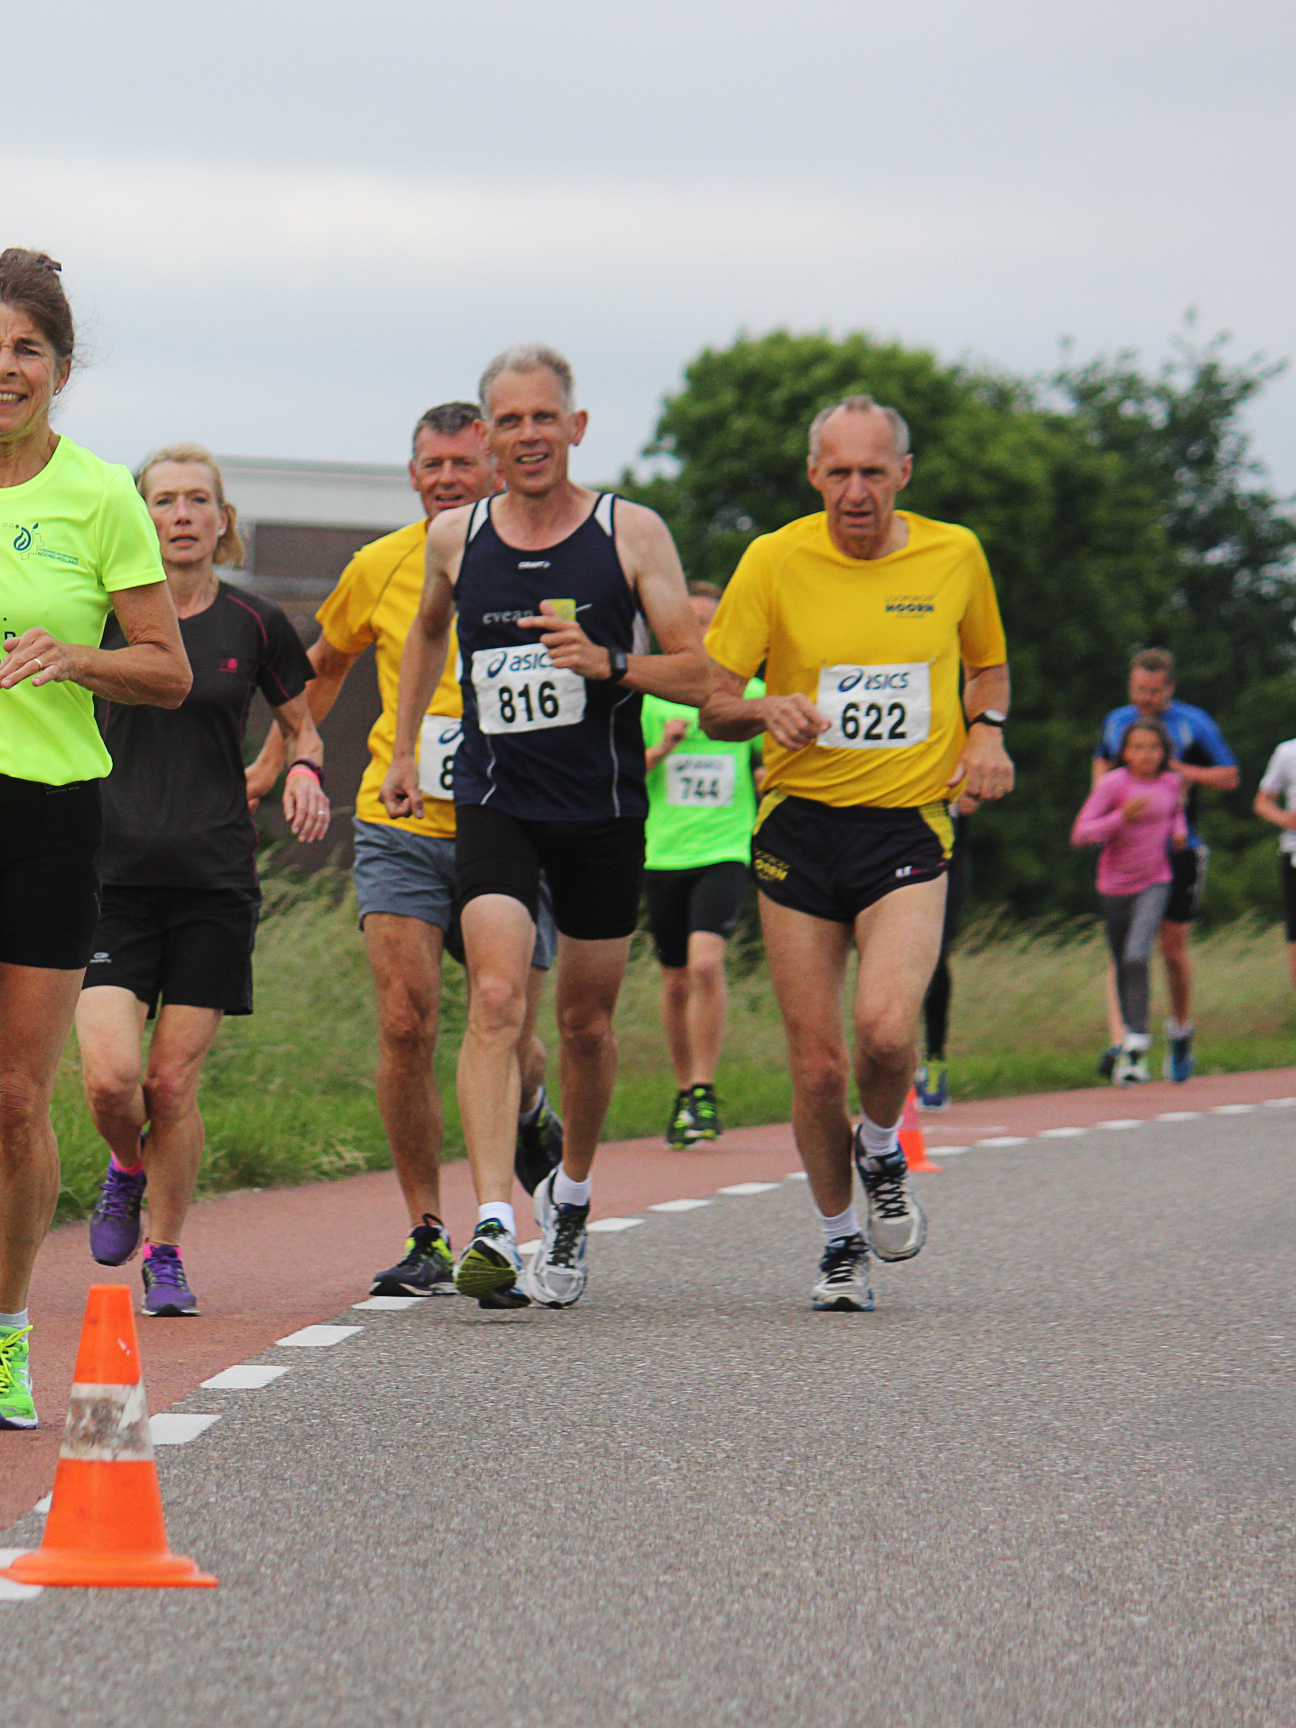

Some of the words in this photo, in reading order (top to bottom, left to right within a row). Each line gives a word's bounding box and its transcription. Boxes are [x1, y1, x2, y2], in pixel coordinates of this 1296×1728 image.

[509, 652, 553, 672] asic
[498, 680, 560, 724] 816
[840, 702, 908, 741] 622
[680, 777, 719, 801] 744
